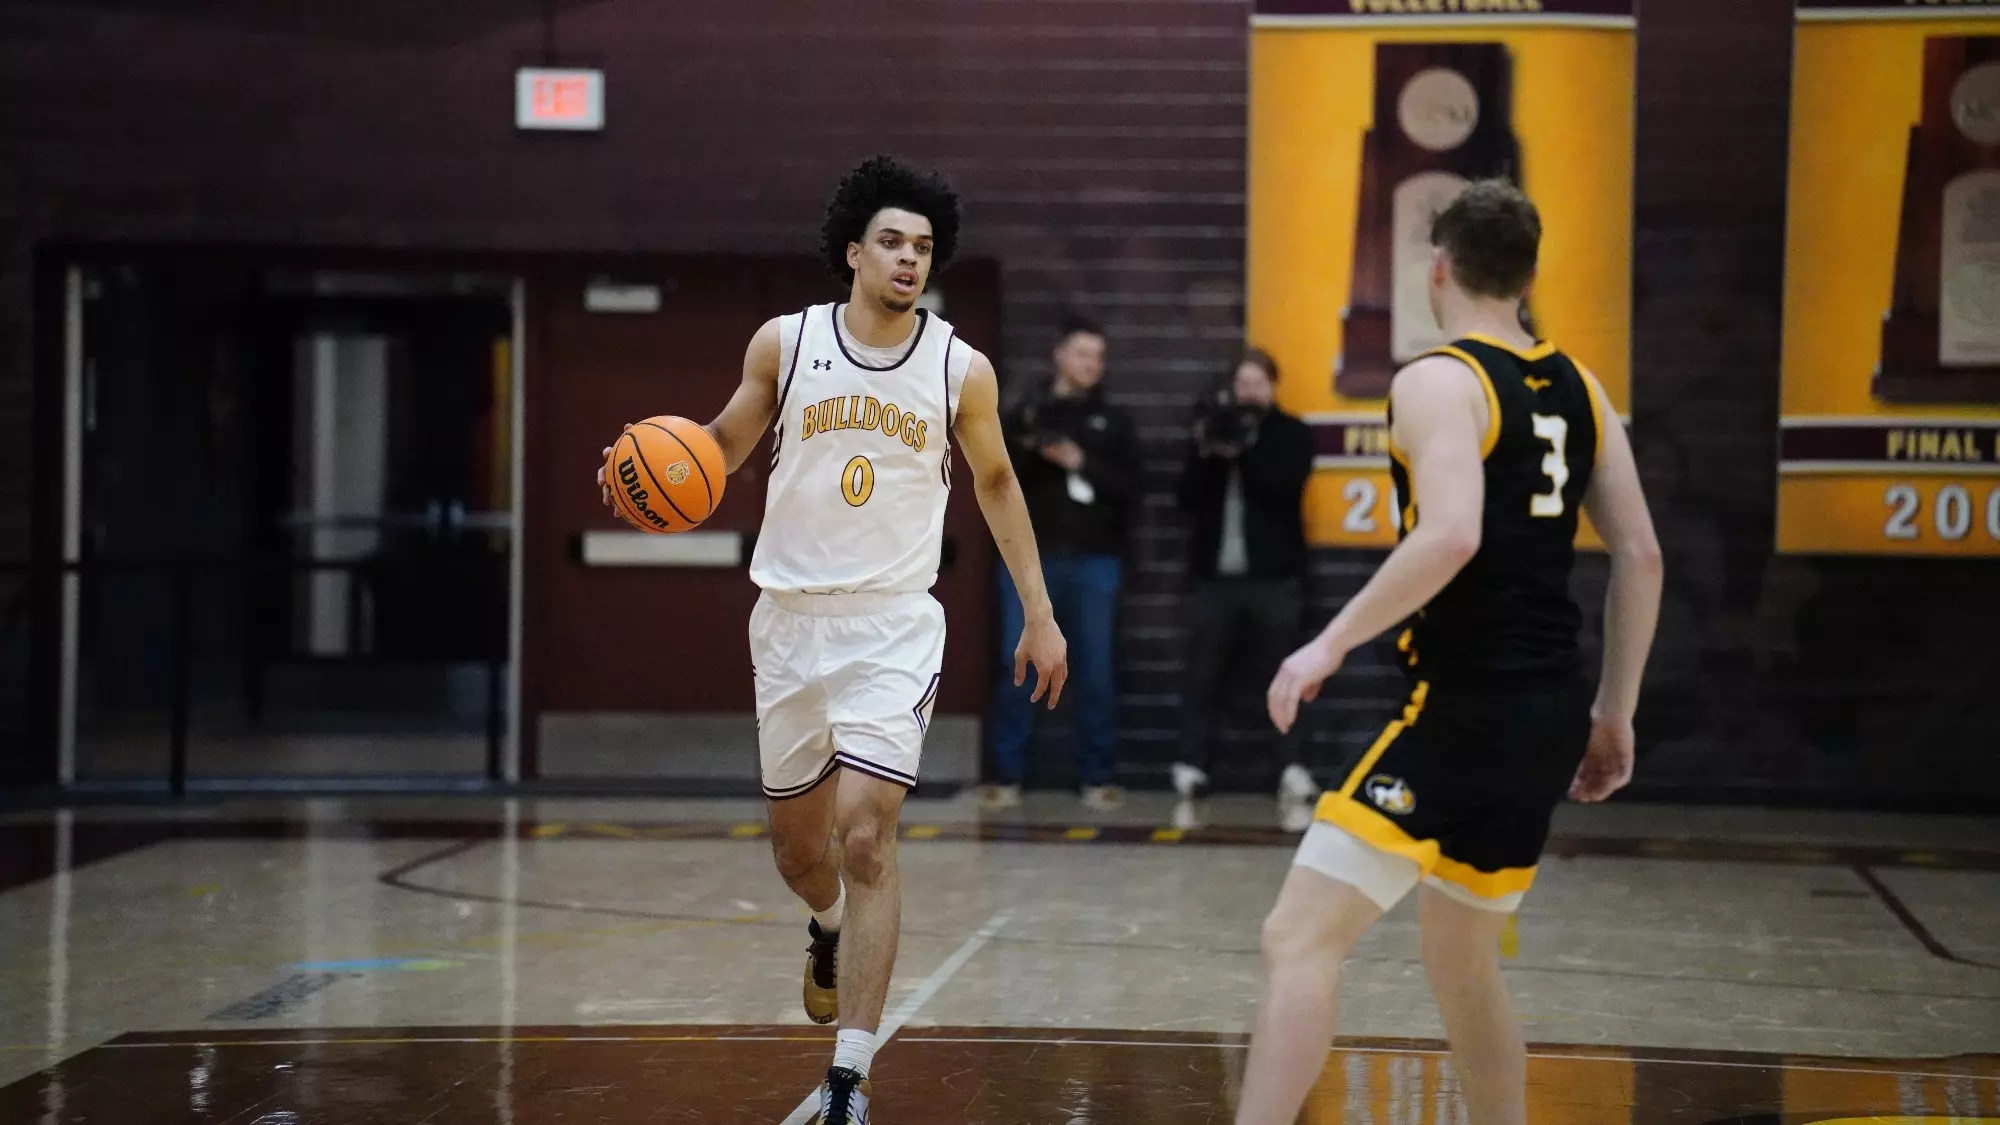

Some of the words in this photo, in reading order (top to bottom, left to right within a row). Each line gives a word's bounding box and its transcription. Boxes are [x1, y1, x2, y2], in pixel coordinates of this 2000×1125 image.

[801, 396, 927, 452] BULLDOGS
[1887, 429, 1982, 459] FINAL
[618, 456, 670, 529] Wilson
[841, 455, 874, 507] 0
[1530, 412, 1569, 517] 3
